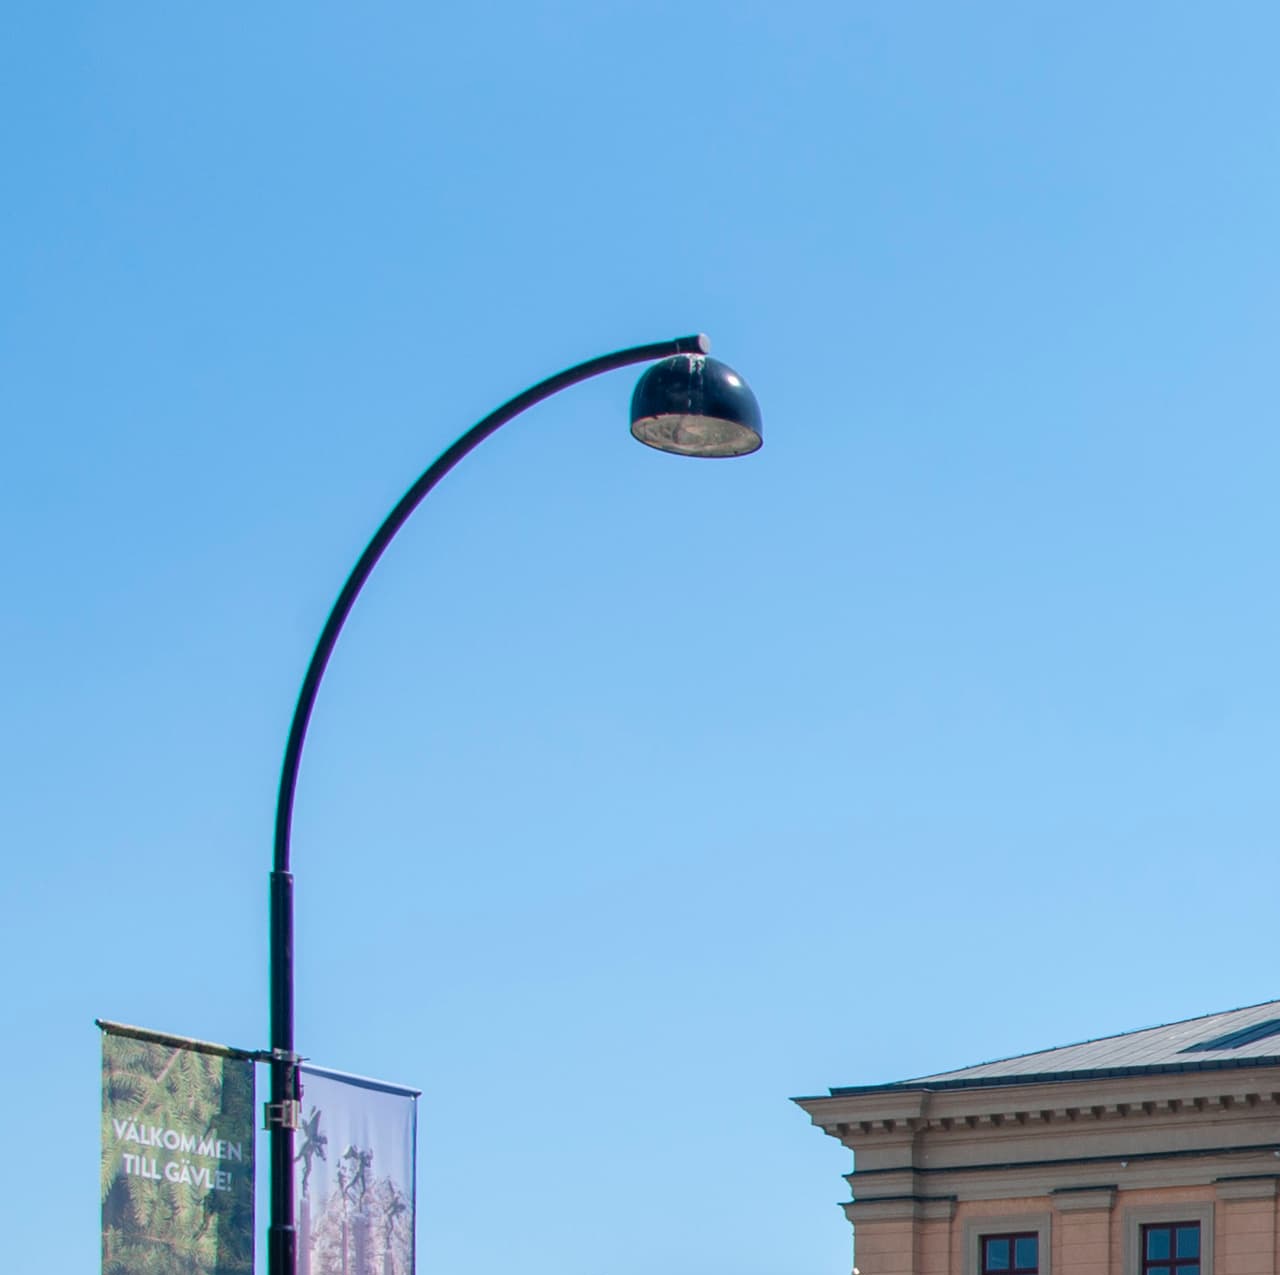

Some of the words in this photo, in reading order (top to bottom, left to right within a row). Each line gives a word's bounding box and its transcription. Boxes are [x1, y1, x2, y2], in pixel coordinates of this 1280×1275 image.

[112, 1116, 243, 1162] VÄLKOMMEN
[122, 1152, 162, 1180] TILL
[164, 1159, 233, 1193] GÄVLE!
